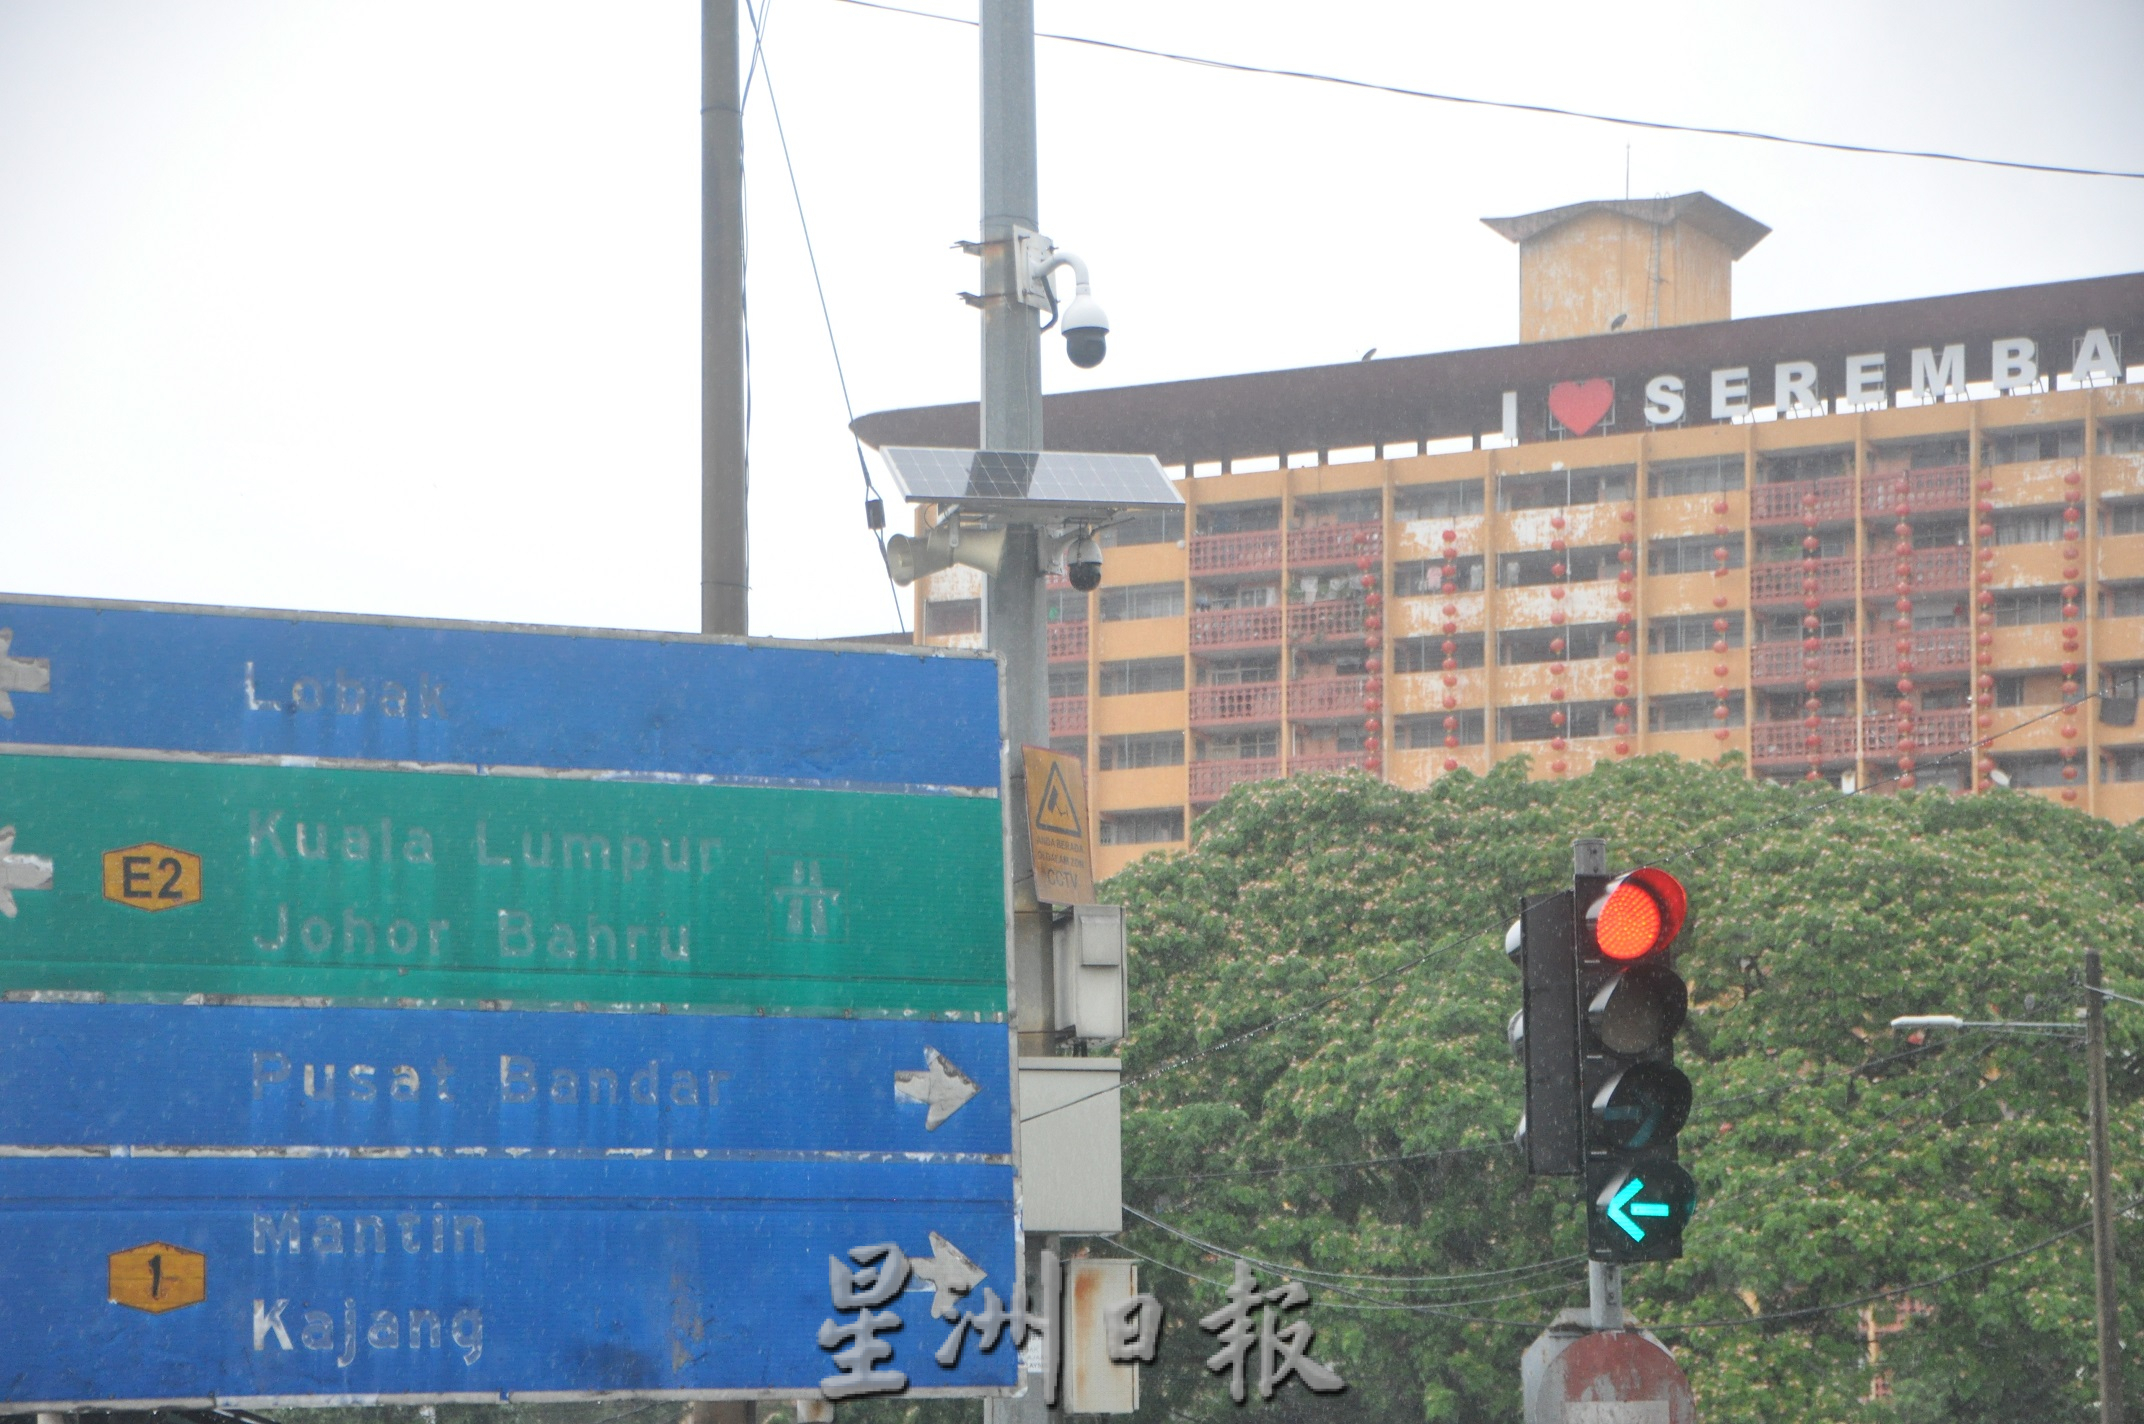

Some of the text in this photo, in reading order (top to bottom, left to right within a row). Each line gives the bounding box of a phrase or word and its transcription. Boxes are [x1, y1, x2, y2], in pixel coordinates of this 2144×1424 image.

[1502, 327, 2122, 440] I SEREMBA
[243, 660, 450, 720] Lobak
[247, 809, 724, 884] Kuala Lumpur
[122, 856, 183, 901] E2
[1047, 867, 1078, 889] CCTV
[252, 903, 691, 962] Johor Bahru
[252, 1050, 732, 1107] Pusat Bandar
[252, 1202, 486, 1255] Mantin
[147, 1253, 162, 1300] 1
[252, 1299, 484, 1368] Kajang
